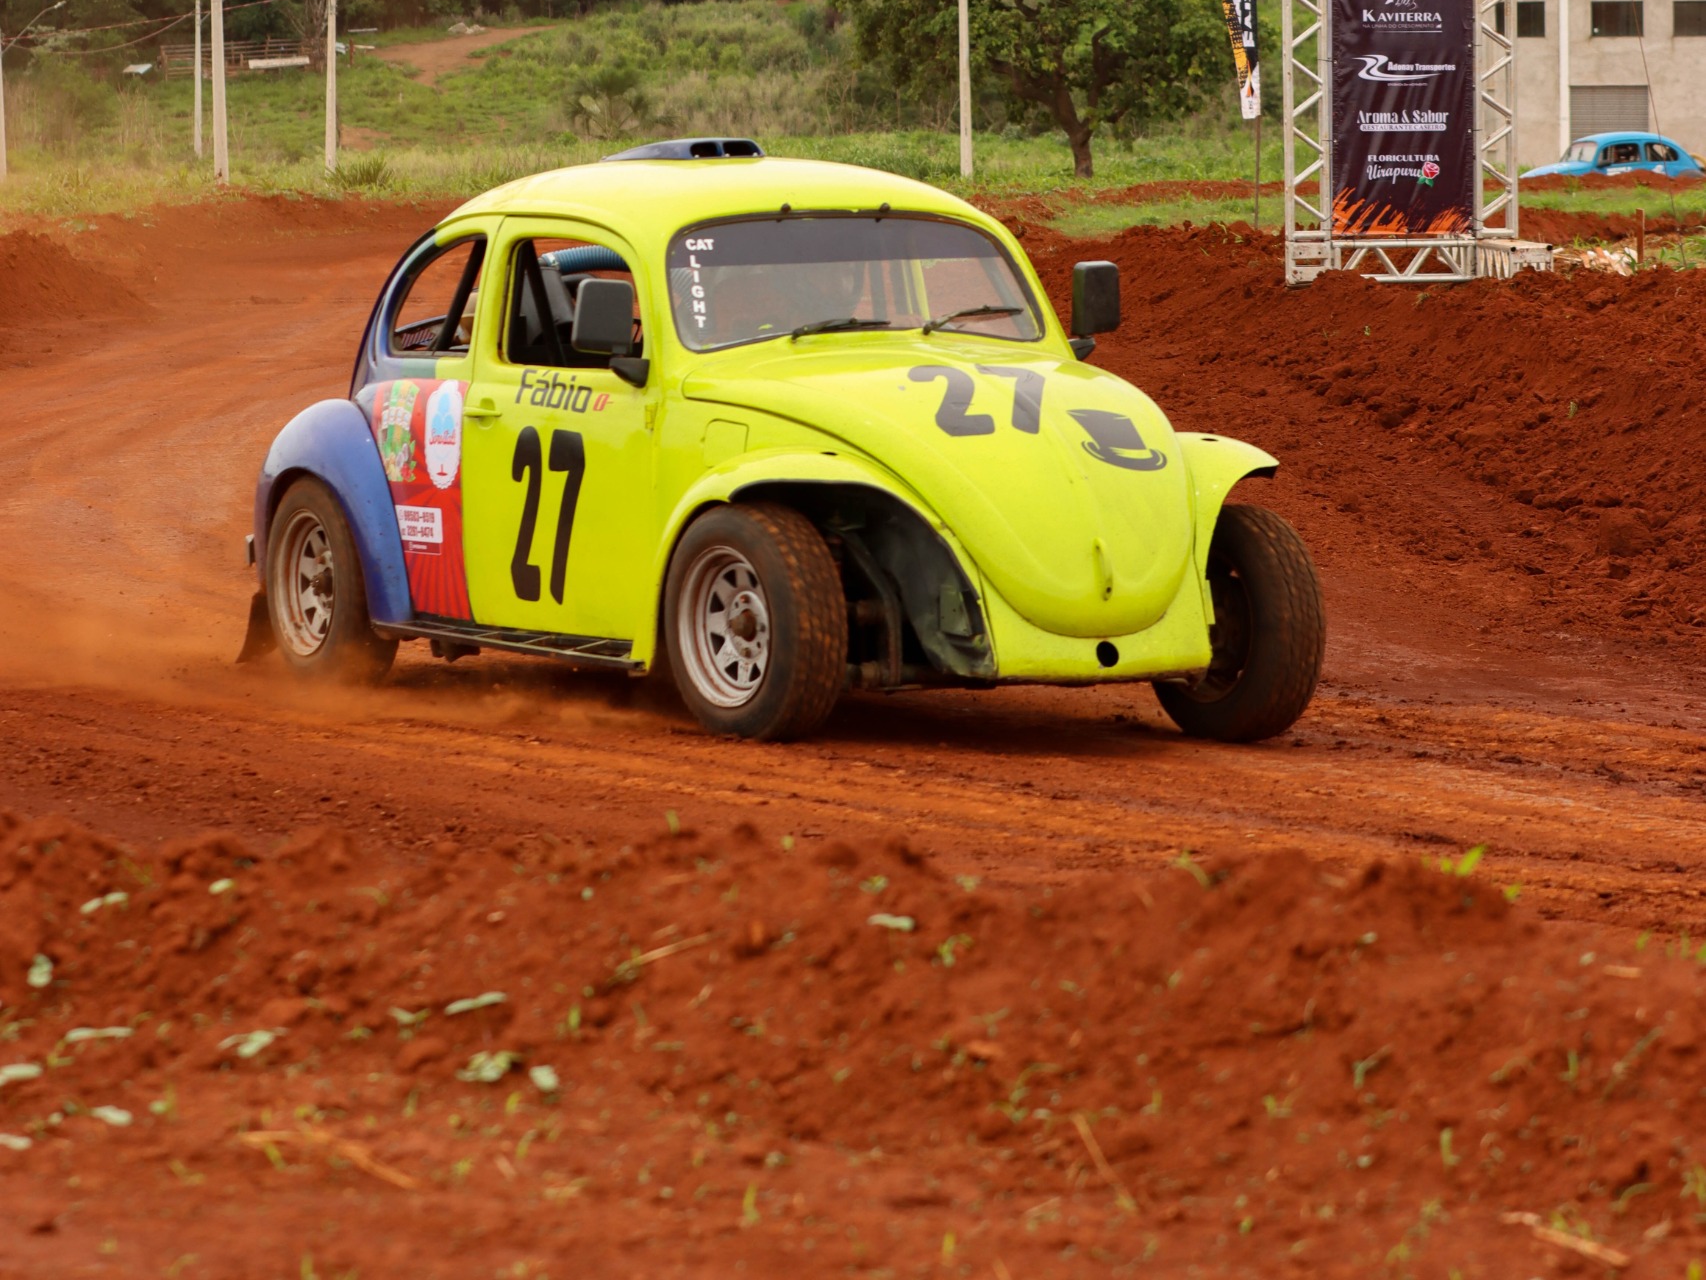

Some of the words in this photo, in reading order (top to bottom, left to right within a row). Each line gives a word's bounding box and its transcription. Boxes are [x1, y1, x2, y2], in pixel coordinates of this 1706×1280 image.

[1387, 61, 1414, 72] Adonay
[1414, 63, 1456, 72] Transportes
[1356, 109, 1399, 124] Aroma
[1401, 109, 1410, 124] &
[1412, 109, 1450, 124] Sabor
[1367, 154, 1440, 162] FLORICULTURA
[1366, 163, 1422, 184] Uirapuru
[685, 238, 715, 251] CAT
[689, 254, 707, 328] LIGHT
[514, 368, 593, 414] Fábio
[907, 363, 1046, 438] 27
[510, 425, 586, 606] 27
